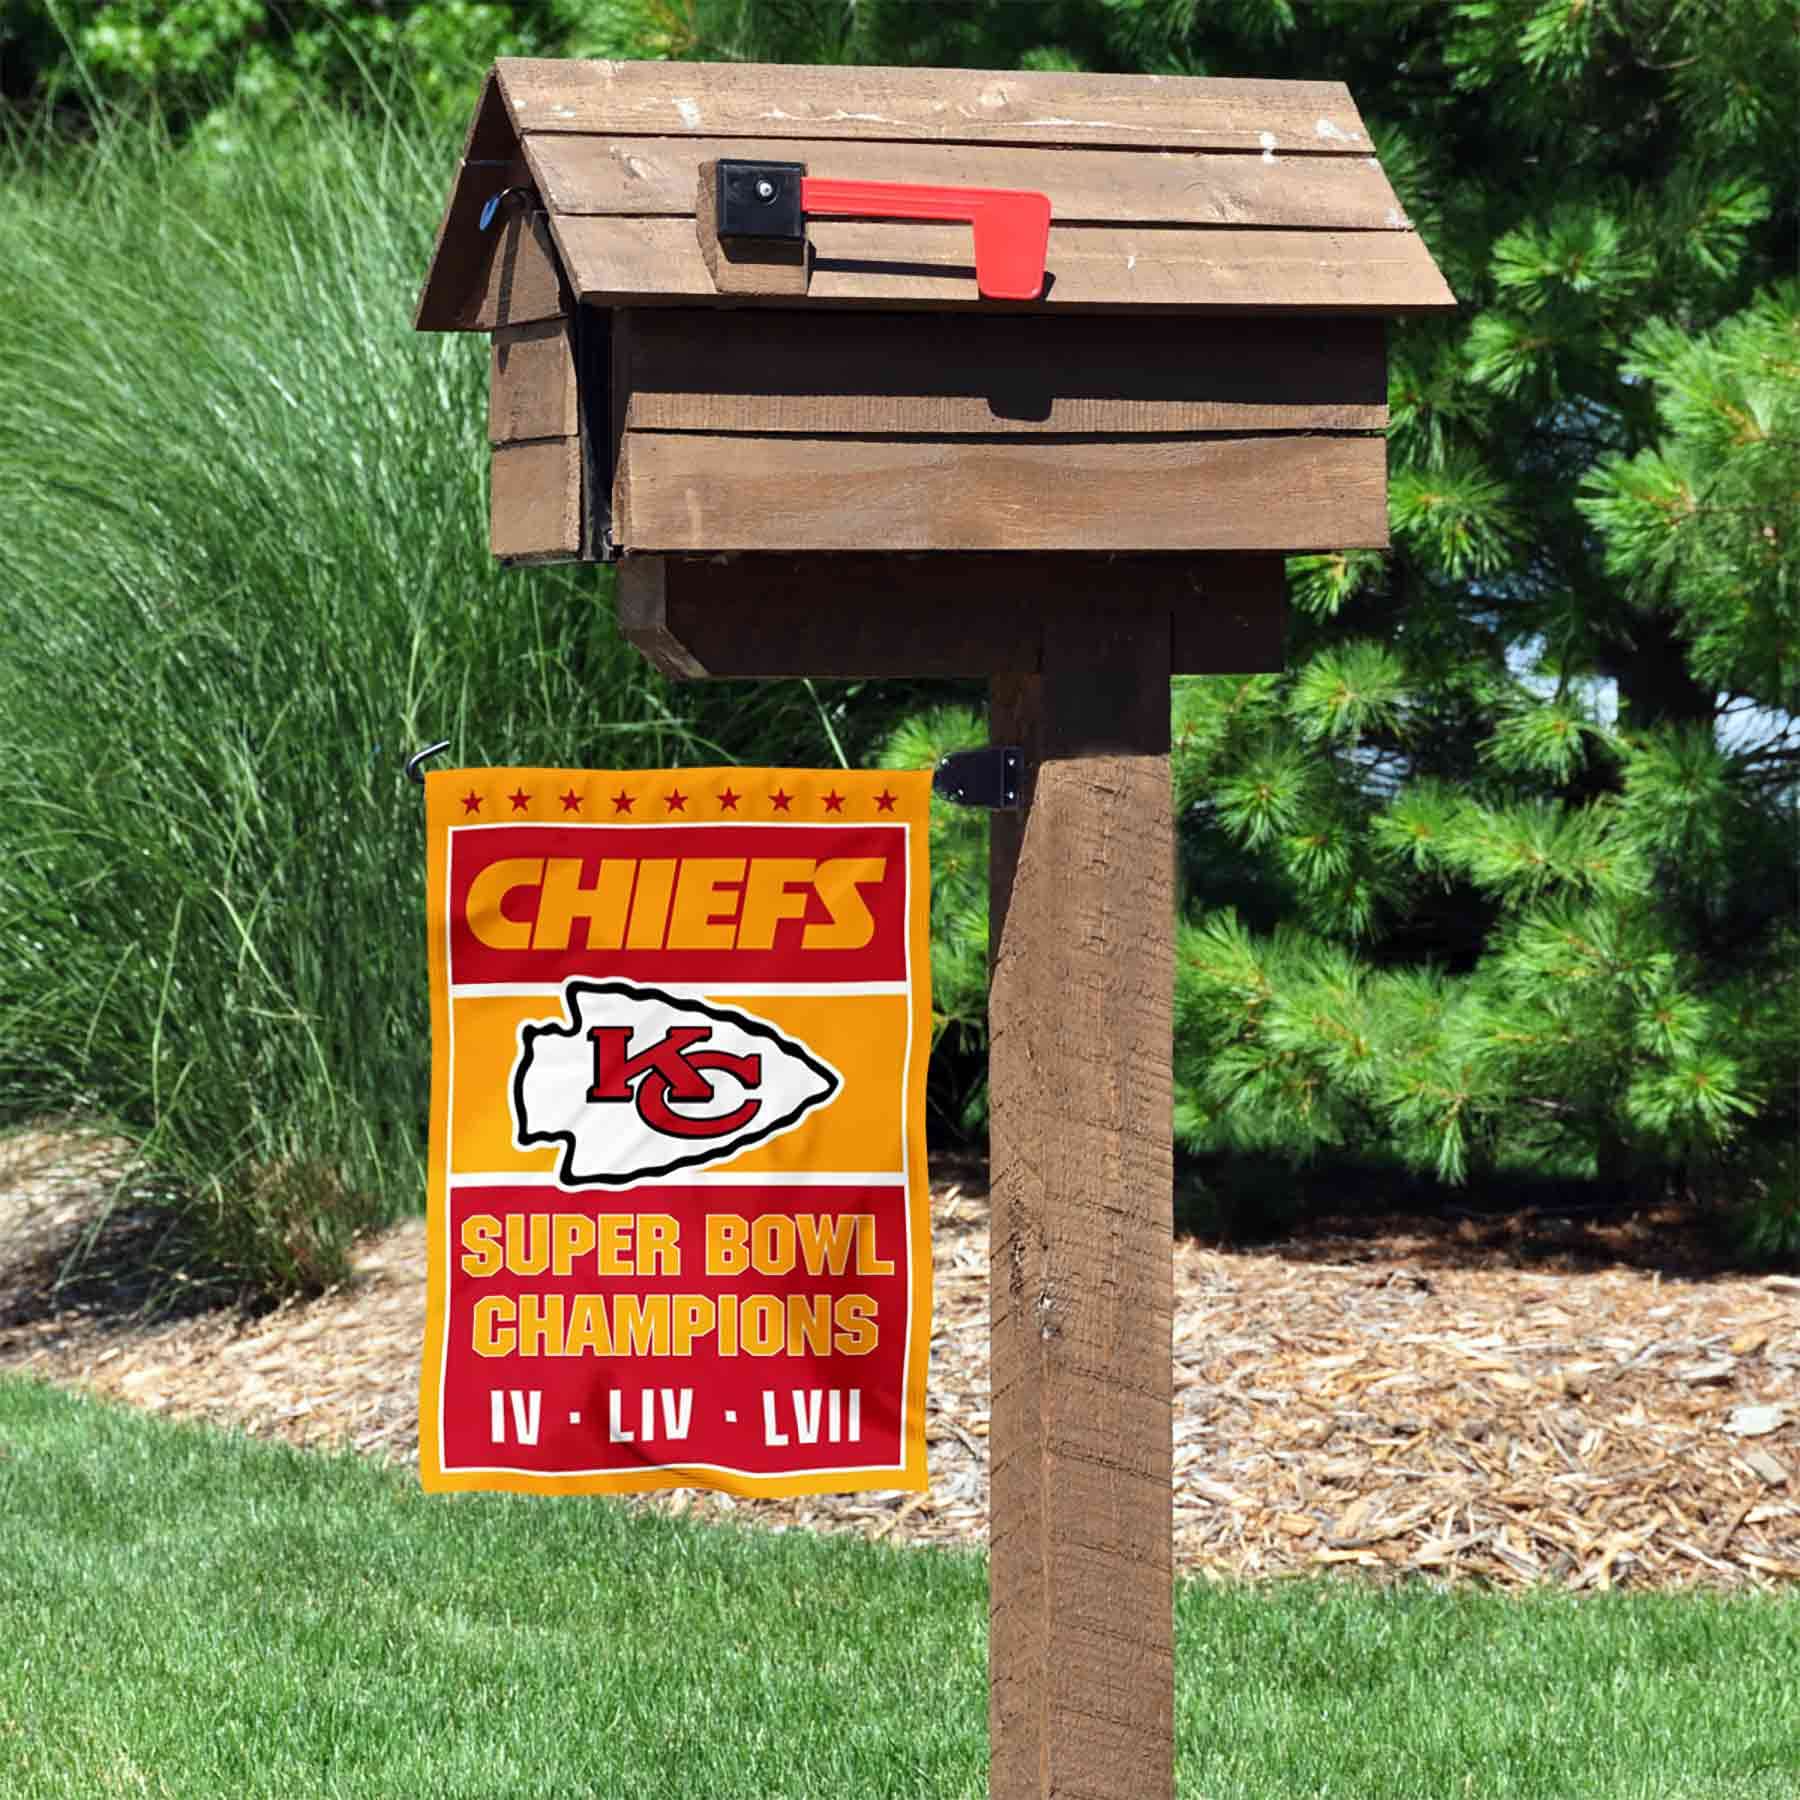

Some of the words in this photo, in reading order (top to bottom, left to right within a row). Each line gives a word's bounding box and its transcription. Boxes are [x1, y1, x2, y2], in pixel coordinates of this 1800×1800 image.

[465, 857, 887, 950] CHIEFS
[586, 1026, 762, 1138] KC
[461, 1213, 681, 1278] SUPER
[705, 1213, 896, 1277] BOWL
[472, 1294, 879, 1358] CHAMPIONS
[490, 1389, 543, 1446] IV
[609, 1388, 694, 1443] LIV
[762, 1388, 861, 1447] LVII
